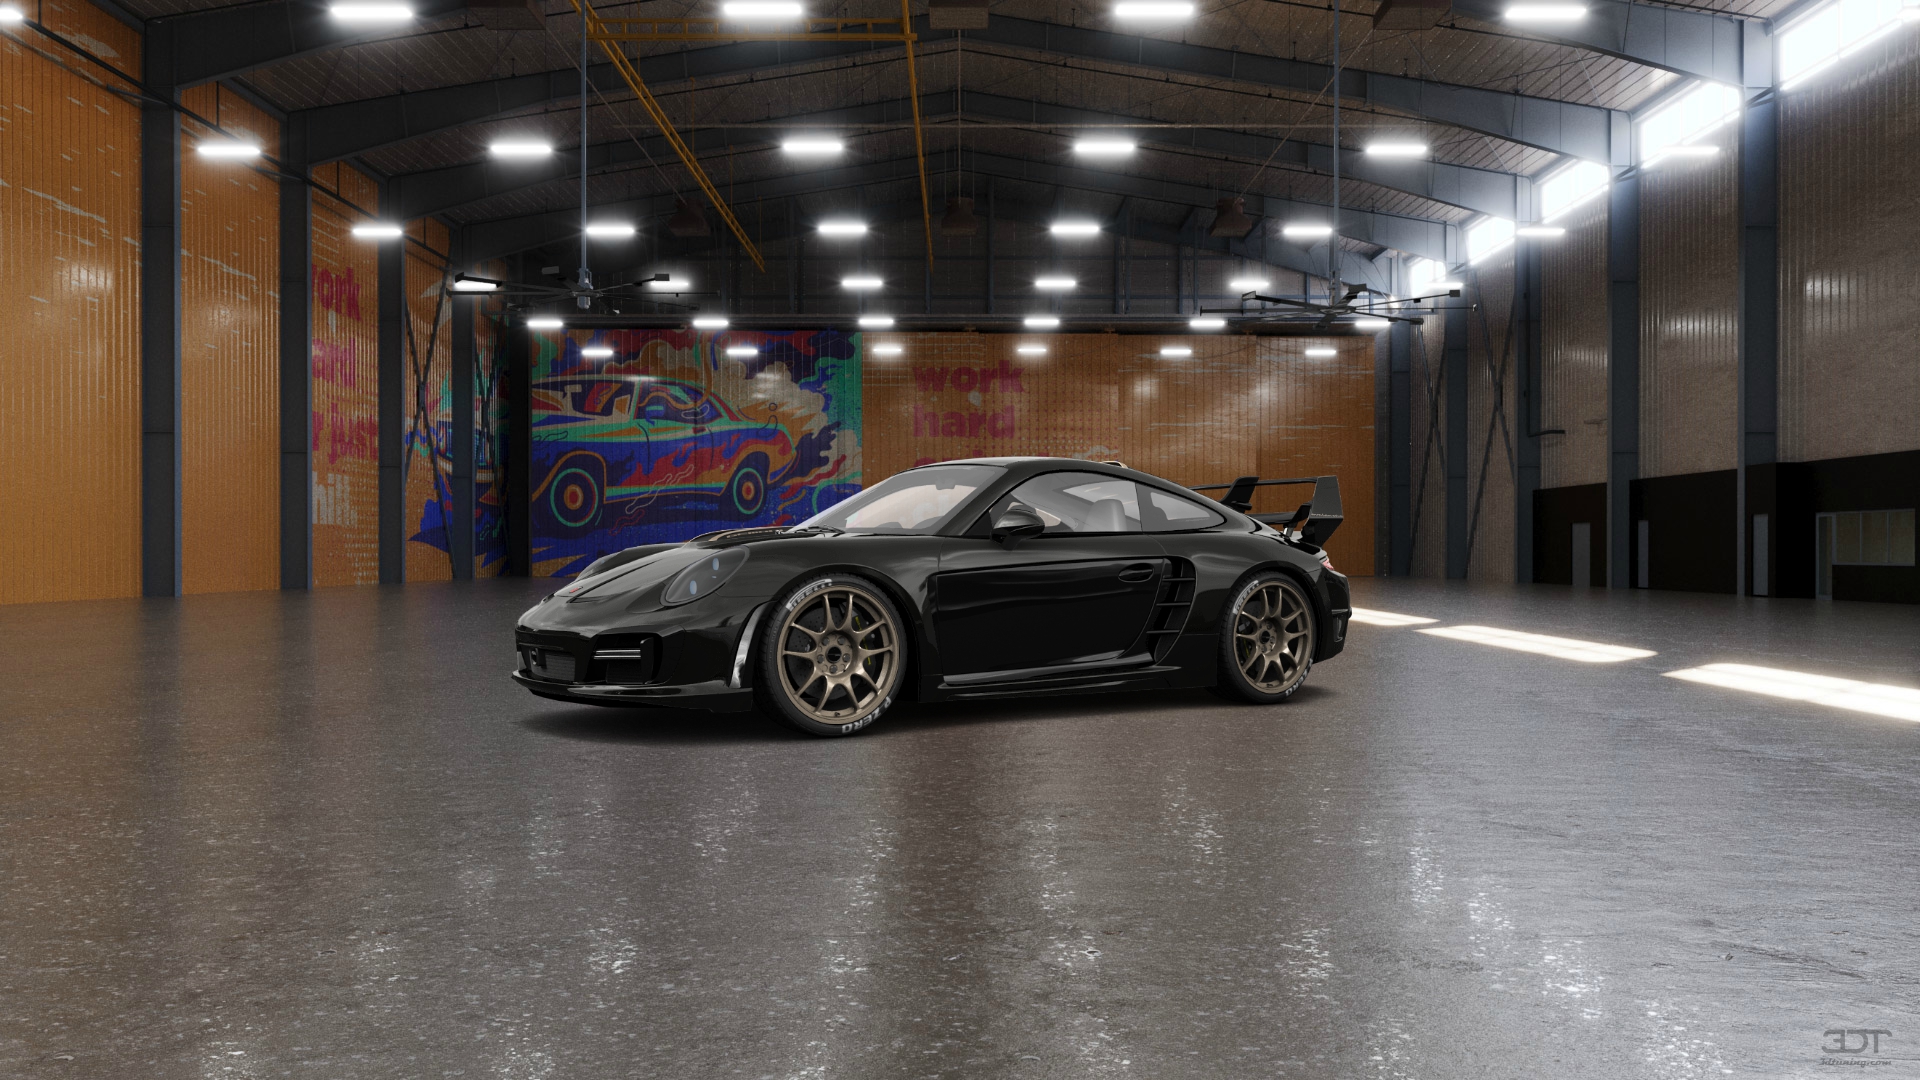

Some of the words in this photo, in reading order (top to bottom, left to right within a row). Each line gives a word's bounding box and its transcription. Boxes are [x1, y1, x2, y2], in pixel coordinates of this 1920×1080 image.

[312, 264, 361, 321] ork
[312, 338, 355, 390] ard
[912, 360, 1025, 393] work
[913, 404, 1015, 439] hard
[312, 471, 358, 527] hill.
[842, 707, 882, 734] ZERO
